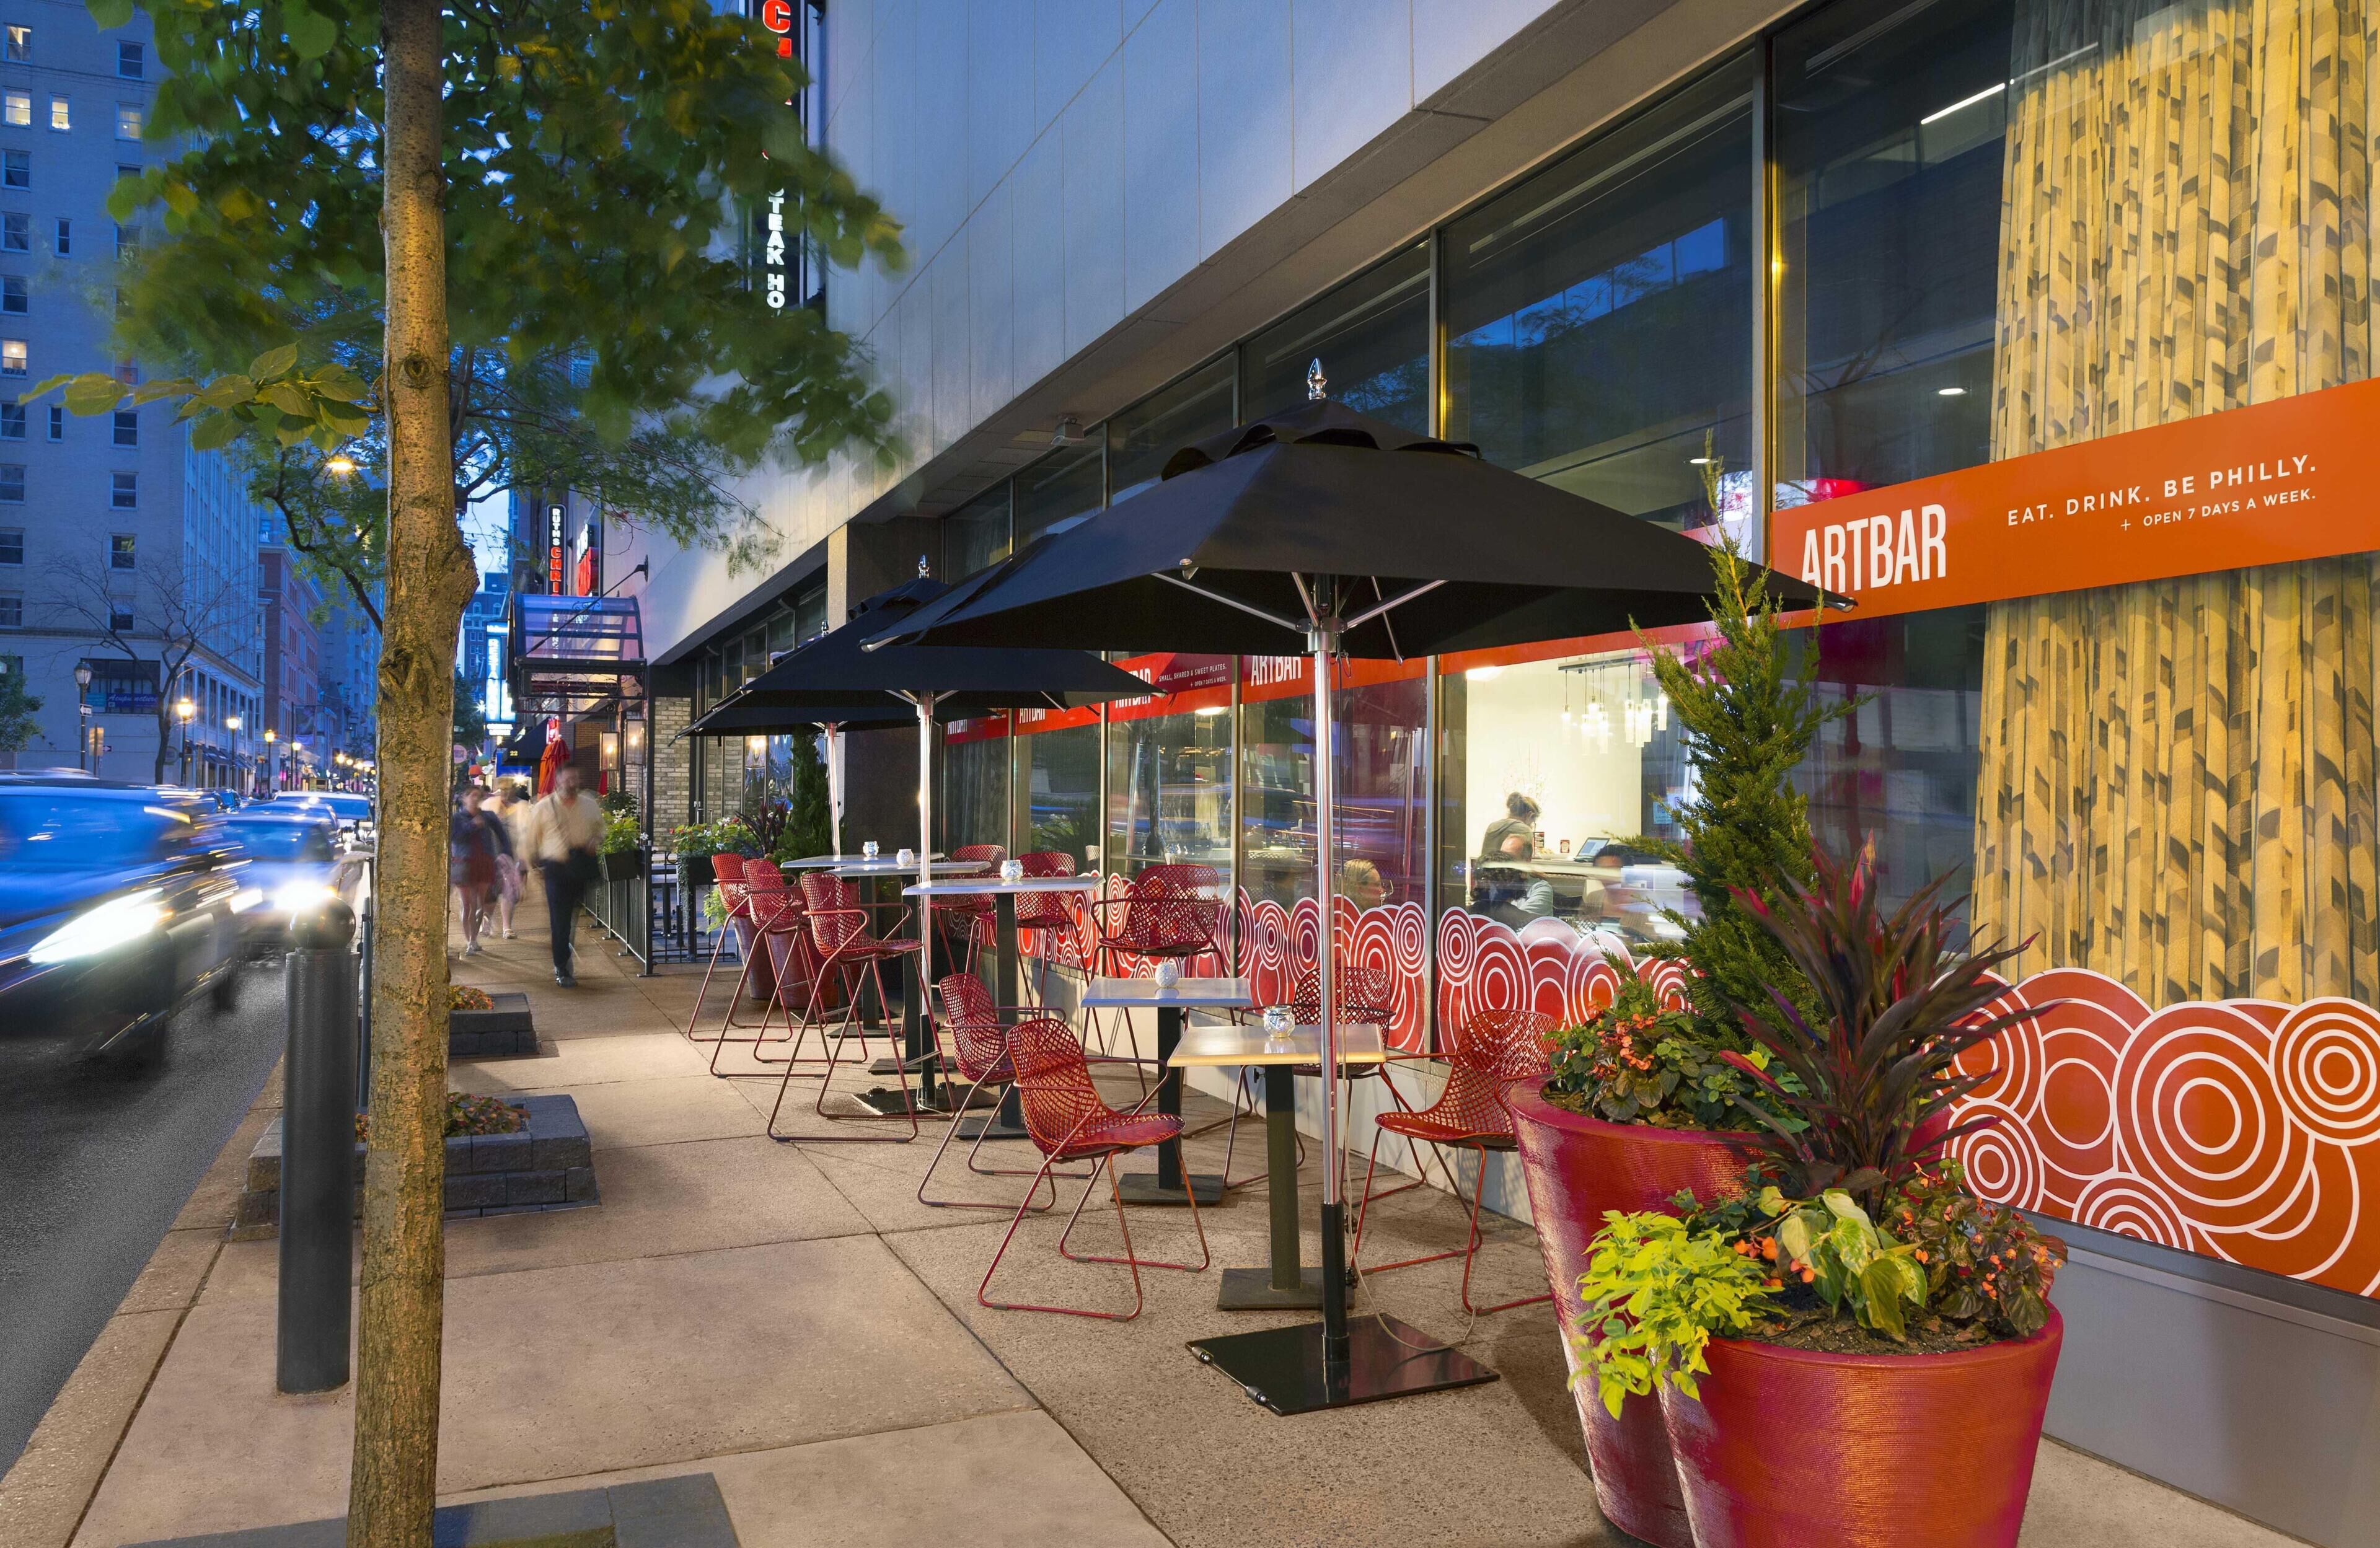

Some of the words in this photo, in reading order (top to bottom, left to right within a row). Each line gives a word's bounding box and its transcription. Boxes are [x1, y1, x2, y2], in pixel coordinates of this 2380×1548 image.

[2008, 504, 2053, 526] EAT.
[2066, 486, 2150, 515] DRINK.
[2164, 476, 2195, 498] BE
[2210, 455, 2316, 490] PHILLY.
[2143, 511, 2182, 526] OPEN
[2188, 508, 2195, 519] 7
[2202, 500, 2239, 517] DAYS
[2246, 498, 2256, 509] A
[2263, 488, 2316, 506] WEEK.
[550, 547, 561, 596] CHRI
[1801, 504, 1946, 593] ARTBAR
[488, 639, 500, 719] RESTAUT
[1174, 671, 1189, 679] SHARED
[1194, 666, 1209, 675] SWEET
[1210, 663, 1227, 672] PLATES.
